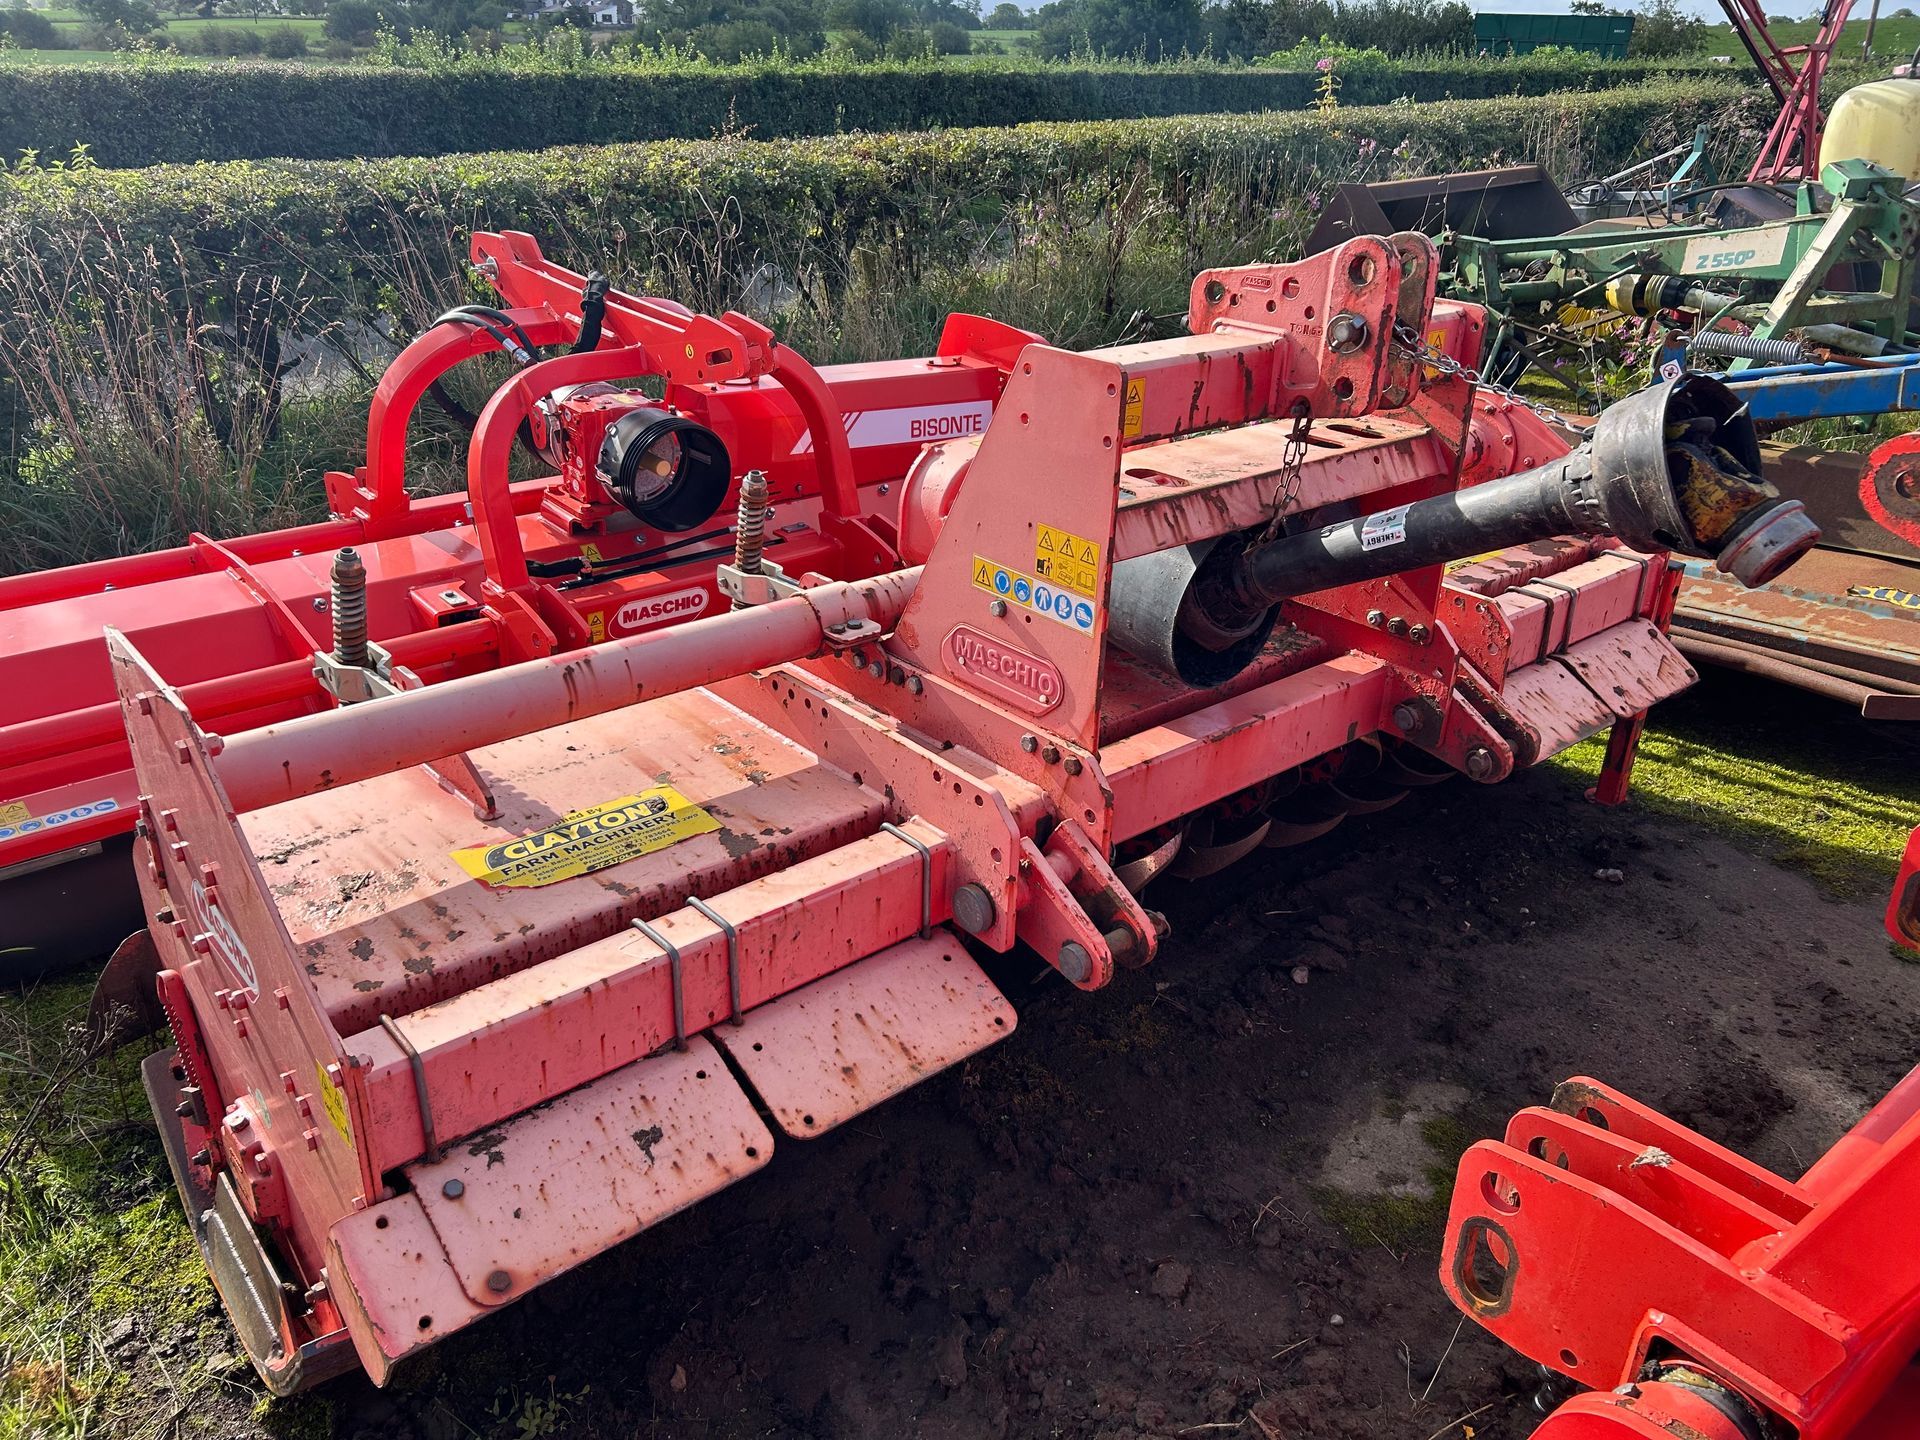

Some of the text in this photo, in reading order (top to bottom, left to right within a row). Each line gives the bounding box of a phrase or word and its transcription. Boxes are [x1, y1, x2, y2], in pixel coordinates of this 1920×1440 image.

[1695, 254, 1710, 270] Z
[910, 413, 982, 438] BISONTE
[1366, 532, 1395, 546] ENERGY
[622, 593, 704, 624] MASCHIO
[955, 634, 1054, 695] MASCHIO
[586, 806, 603, 816] By
[503, 802, 653, 859] CLAYTON
[500, 851, 560, 876] FARM
[563, 811, 677, 855] MACHINERY
[550, 856, 570, 866] Back
